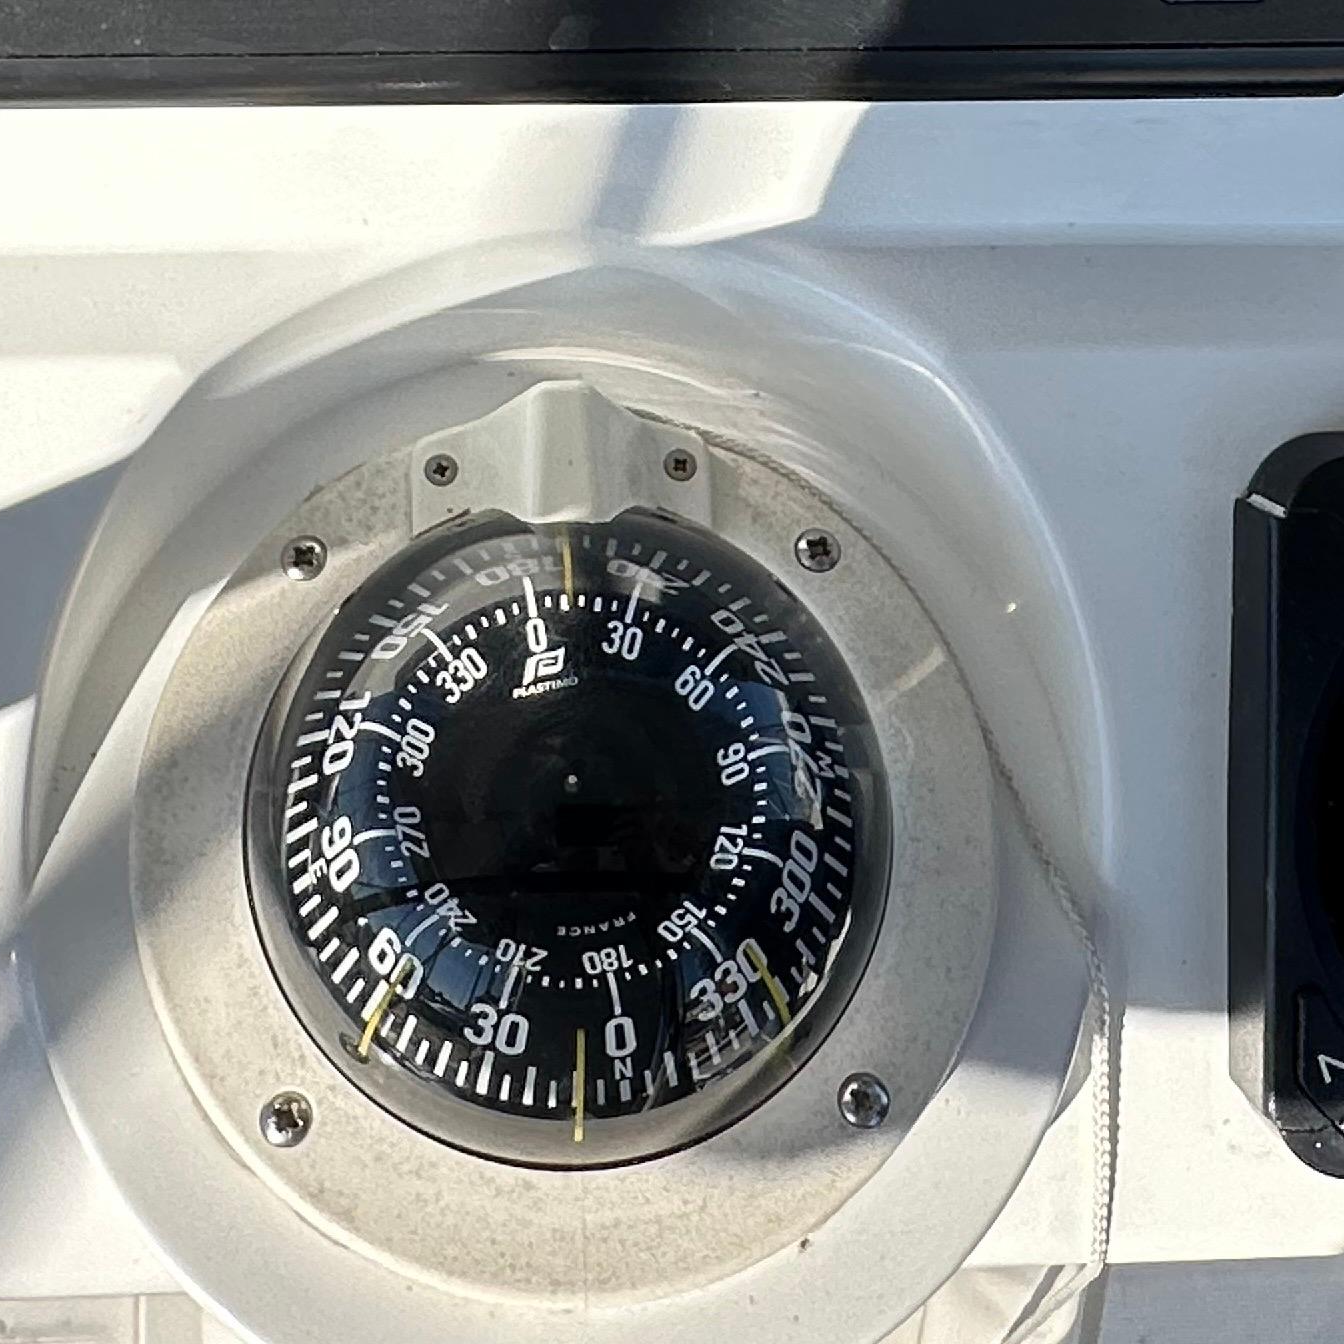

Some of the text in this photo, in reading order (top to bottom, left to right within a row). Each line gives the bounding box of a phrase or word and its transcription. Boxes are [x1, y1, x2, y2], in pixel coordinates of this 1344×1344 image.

[525, 617, 548, 654] 0
[601, 619, 644, 661] 30
[436, 646, 489, 704] 330
[674, 663, 716, 712] 60
[322, 690, 372, 776] 120
[395, 717, 436, 778] 300
[716, 741, 750, 786] 90
[321, 815, 361, 893] 90
[392, 805, 431, 859] 270
[709, 823, 748, 870] 120
[770, 829, 819, 933] 300
[656, 899, 707, 943] 150
[367, 926, 424, 1000] 60
[495, 937, 549, 972] 210
[581, 943, 634, 976] 180
[690, 937, 769, 1022] 330
[463, 1002, 530, 1056] 30
[605, 1016, 638, 1057] 0
[614, 1057, 634, 1080] N
